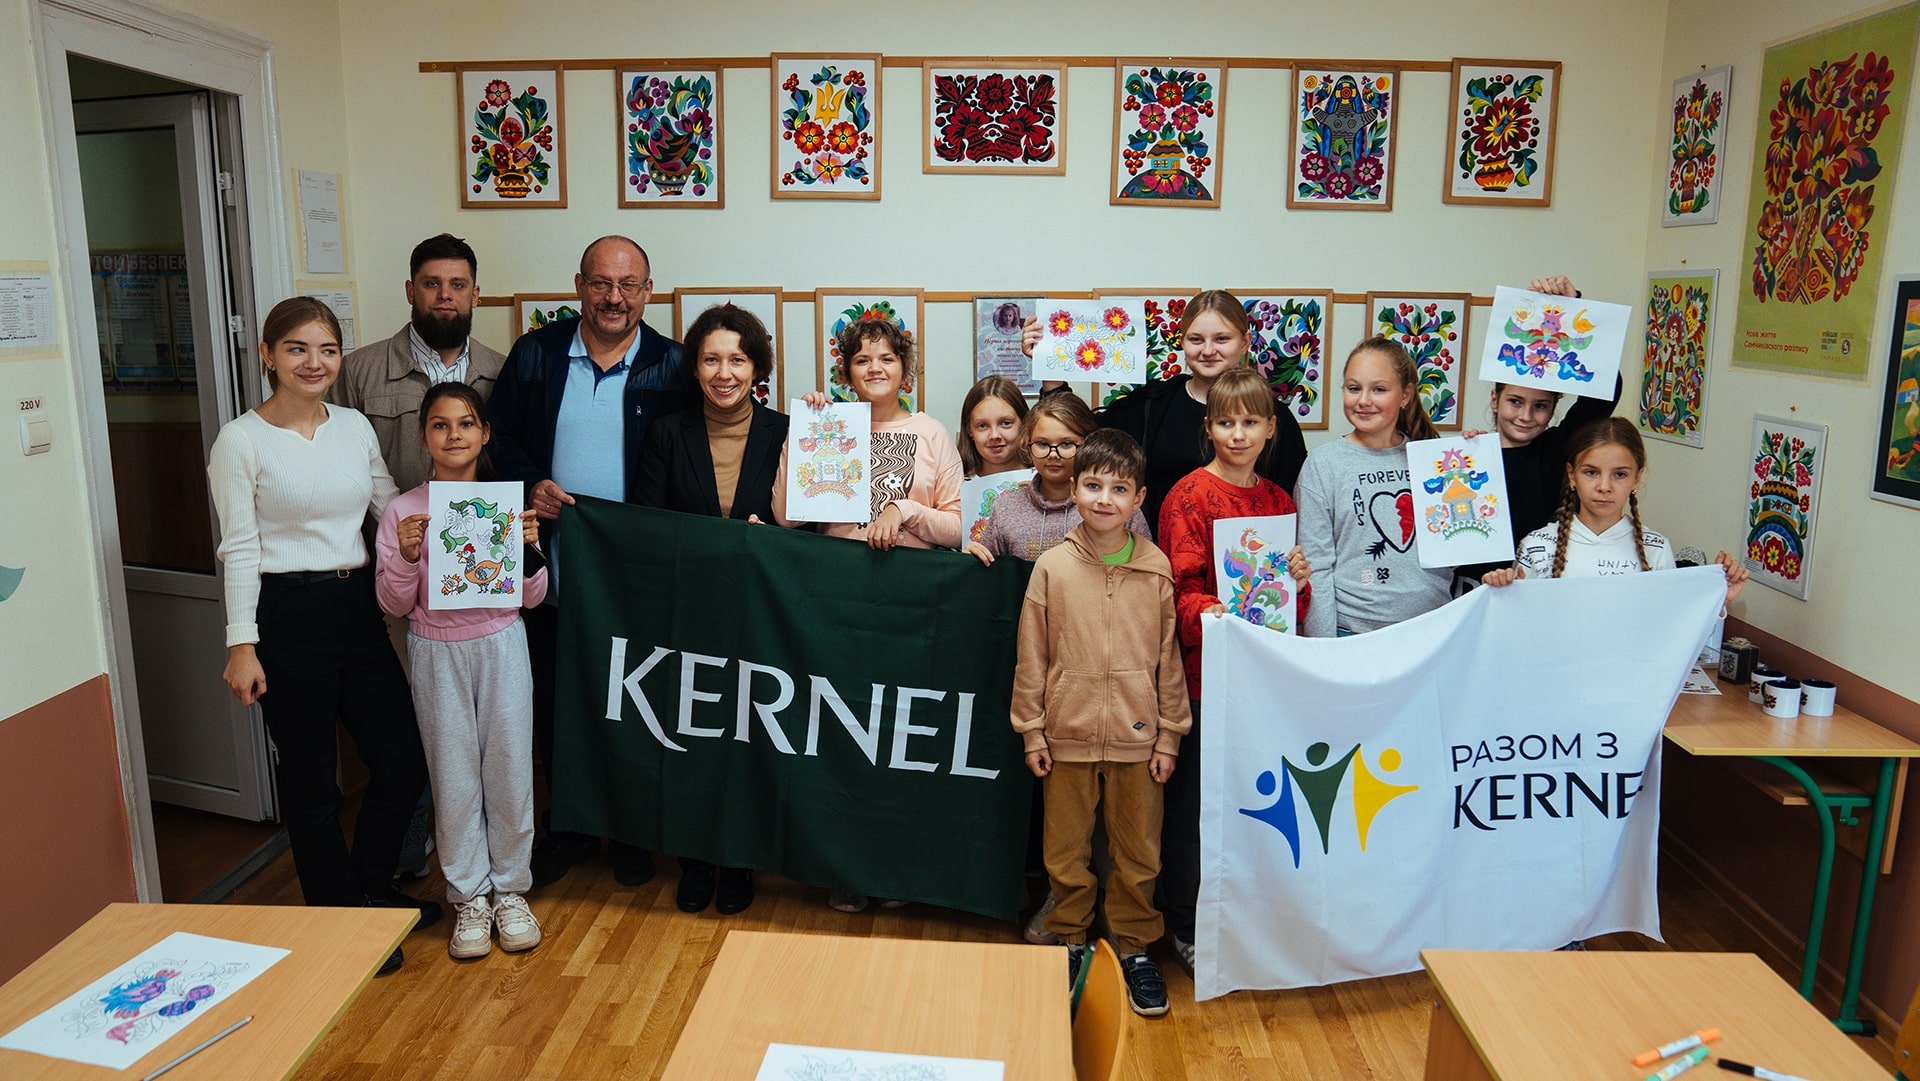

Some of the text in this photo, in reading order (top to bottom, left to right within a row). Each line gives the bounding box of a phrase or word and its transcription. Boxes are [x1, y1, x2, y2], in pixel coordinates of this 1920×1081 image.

[91, 255, 187, 270] ТОК БЕЗПЕК
[1760, 331, 1776, 339] життя
[1784, 345, 1809, 353] розпису
[20, 400, 41, 411] 220 V
[871, 432, 891, 440] OUR
[1358, 469, 1411, 485] FOREVE
[1598, 559, 1638, 570] UNITY
[605, 636, 1001, 780] KERNEL
[1451, 733, 1582, 772] РАЗОМ
[1453, 770, 1644, 831] KERNE
